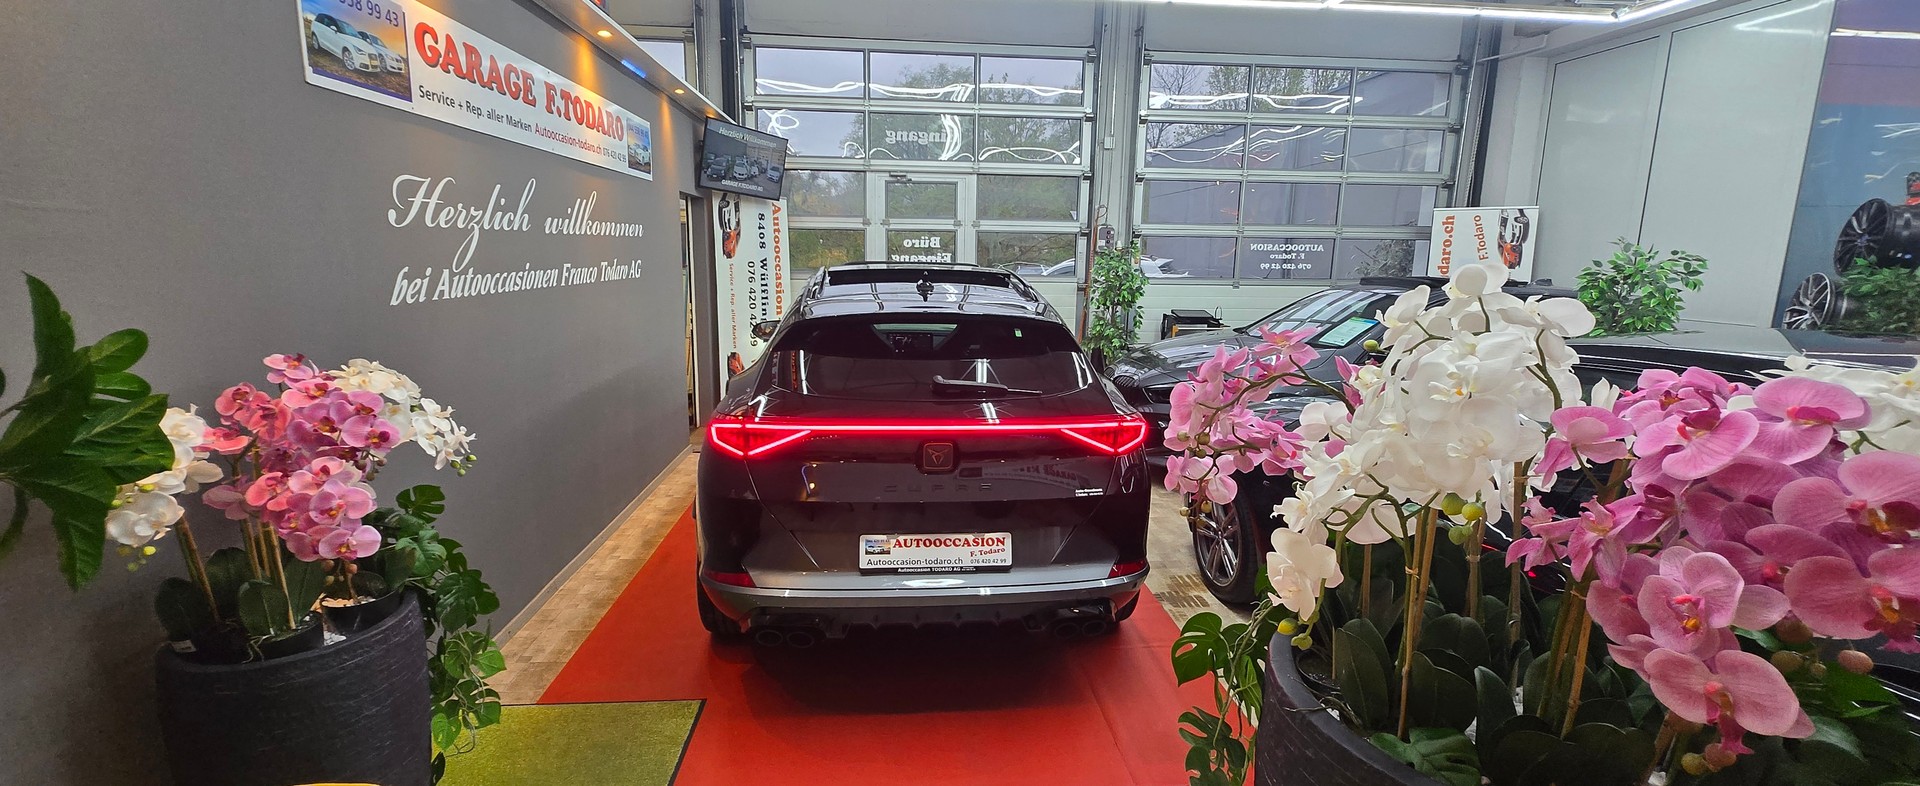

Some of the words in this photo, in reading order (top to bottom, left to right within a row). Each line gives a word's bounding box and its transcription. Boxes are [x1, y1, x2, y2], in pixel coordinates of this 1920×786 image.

[341, 0, 363, 11] 58
[366, 1, 381, 19] 99
[385, 9, 399, 27] 43
[414, 22, 537, 108] GARAGE
[544, 81, 624, 142] F.TODARO
[418, 84, 456, 109] Service
[466, 100, 485, 119] Rep.
[487, 108, 504, 124] aller
[506, 114, 532, 133] Marken
[535, 122, 602, 155] Autooccasion-todaro.ch
[718, 126, 743, 140] Herzlich
[387, 174, 536, 273] Herzlich
[544, 190, 644, 238] willkommen
[758, 212, 767, 250] 8408
[1437, 214, 1455, 277] daro.ch
[389, 266, 433, 307] bei
[432, 262, 558, 301] Autooccasionen
[560, 263, 598, 287] Franco
[599, 258, 628, 282] Todaro
[628, 259, 642, 278] AG
[747, 261, 756, 284] 076
[748, 287, 757, 310] 420
[759, 257, 769, 321] Wülflin
[893, 537, 1006, 548] AUTOOCCASION
[978, 548, 1006, 556] Todaro
[867, 557, 963, 566] Autooccasion-todaro.ch
